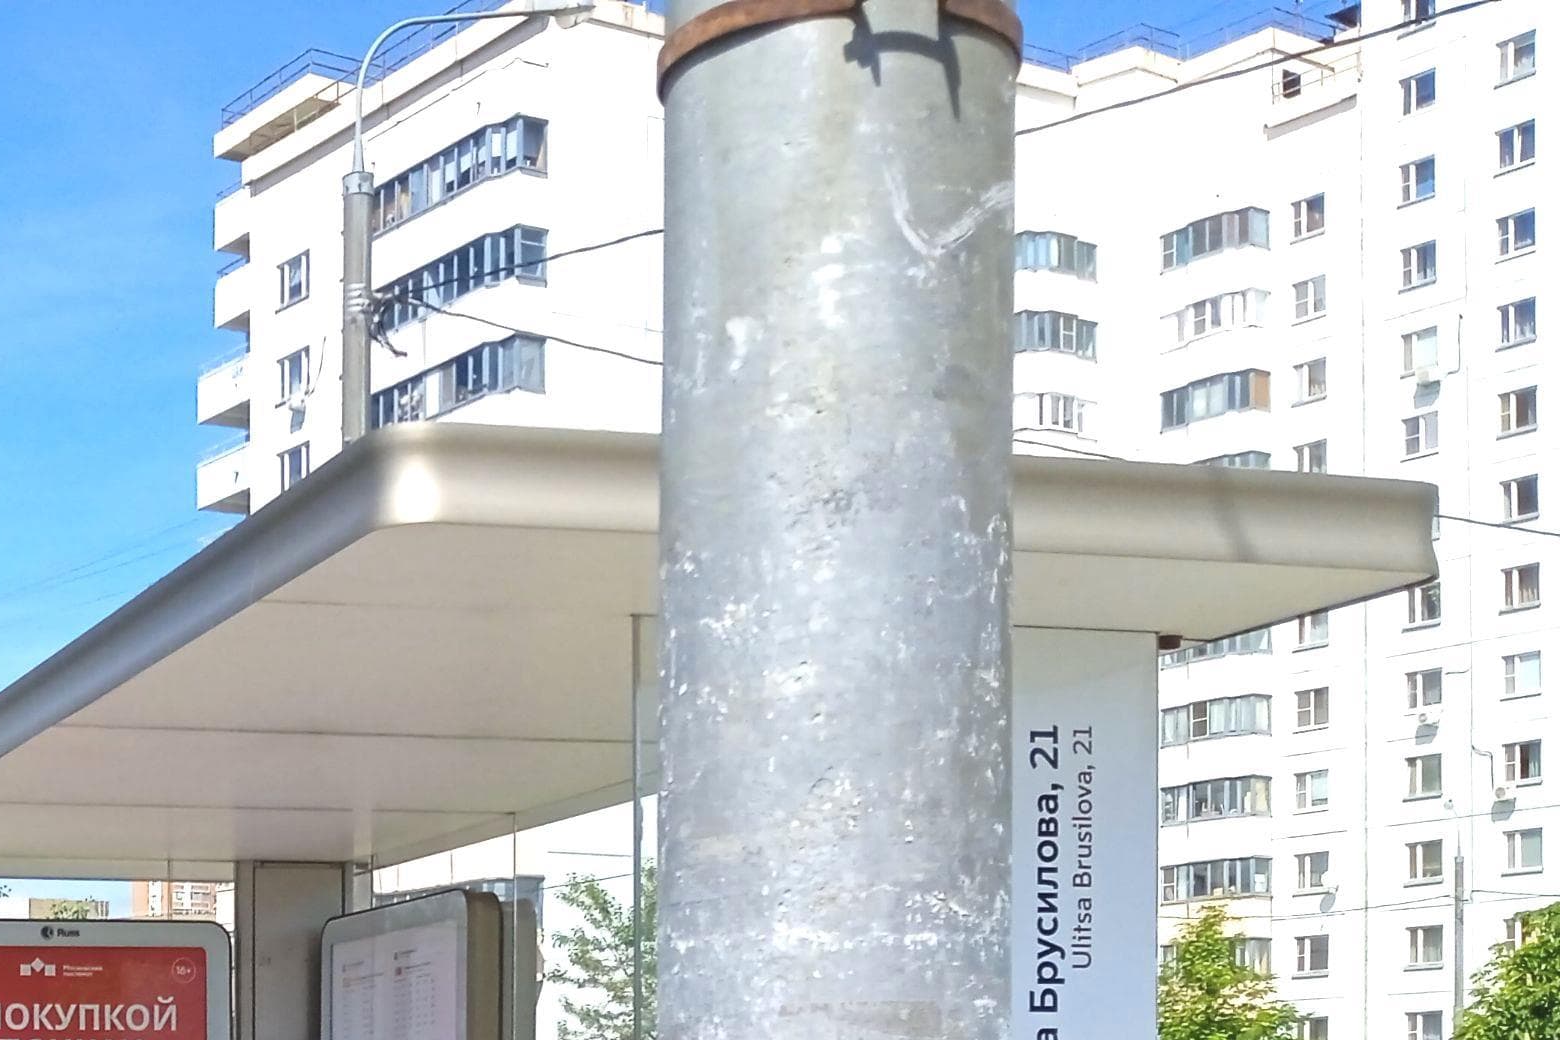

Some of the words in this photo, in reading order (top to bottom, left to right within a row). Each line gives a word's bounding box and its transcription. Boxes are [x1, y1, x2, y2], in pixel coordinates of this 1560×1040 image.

[1030, 725, 1058, 769] 21
[1073, 725, 1092, 755] 21
[1072, 764, 1096, 889] Brusilova,
[1029, 782, 1065, 1013] Брусилова,
[1072, 897, 1092, 969] Ulitsa
